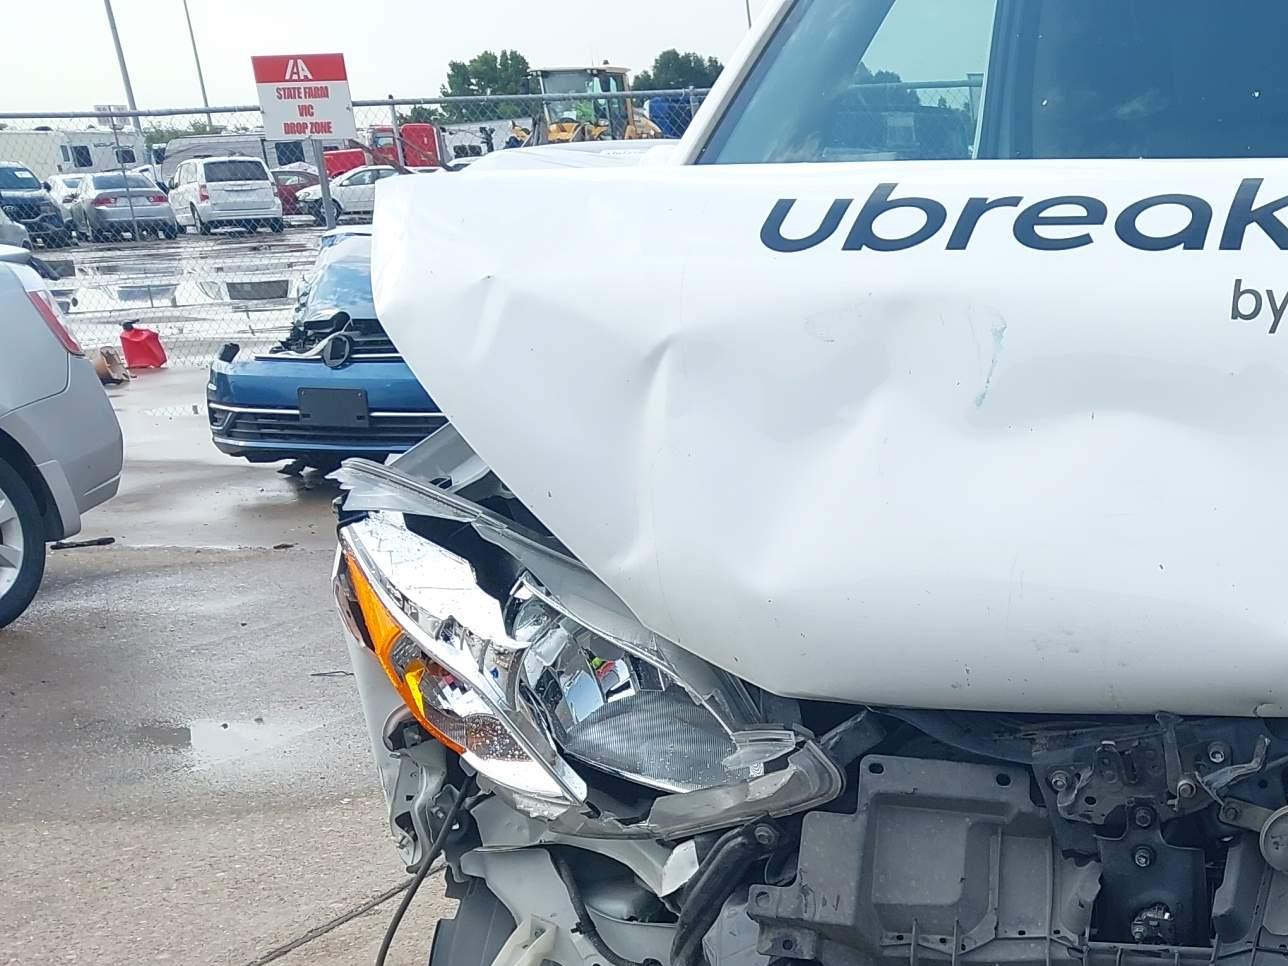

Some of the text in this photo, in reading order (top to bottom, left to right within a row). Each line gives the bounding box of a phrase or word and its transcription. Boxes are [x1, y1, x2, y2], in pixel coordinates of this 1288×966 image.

[276, 86, 329, 100] STATE FARM
[297, 104, 315, 117] VIC
[284, 121, 333, 135] DROP ZONE
